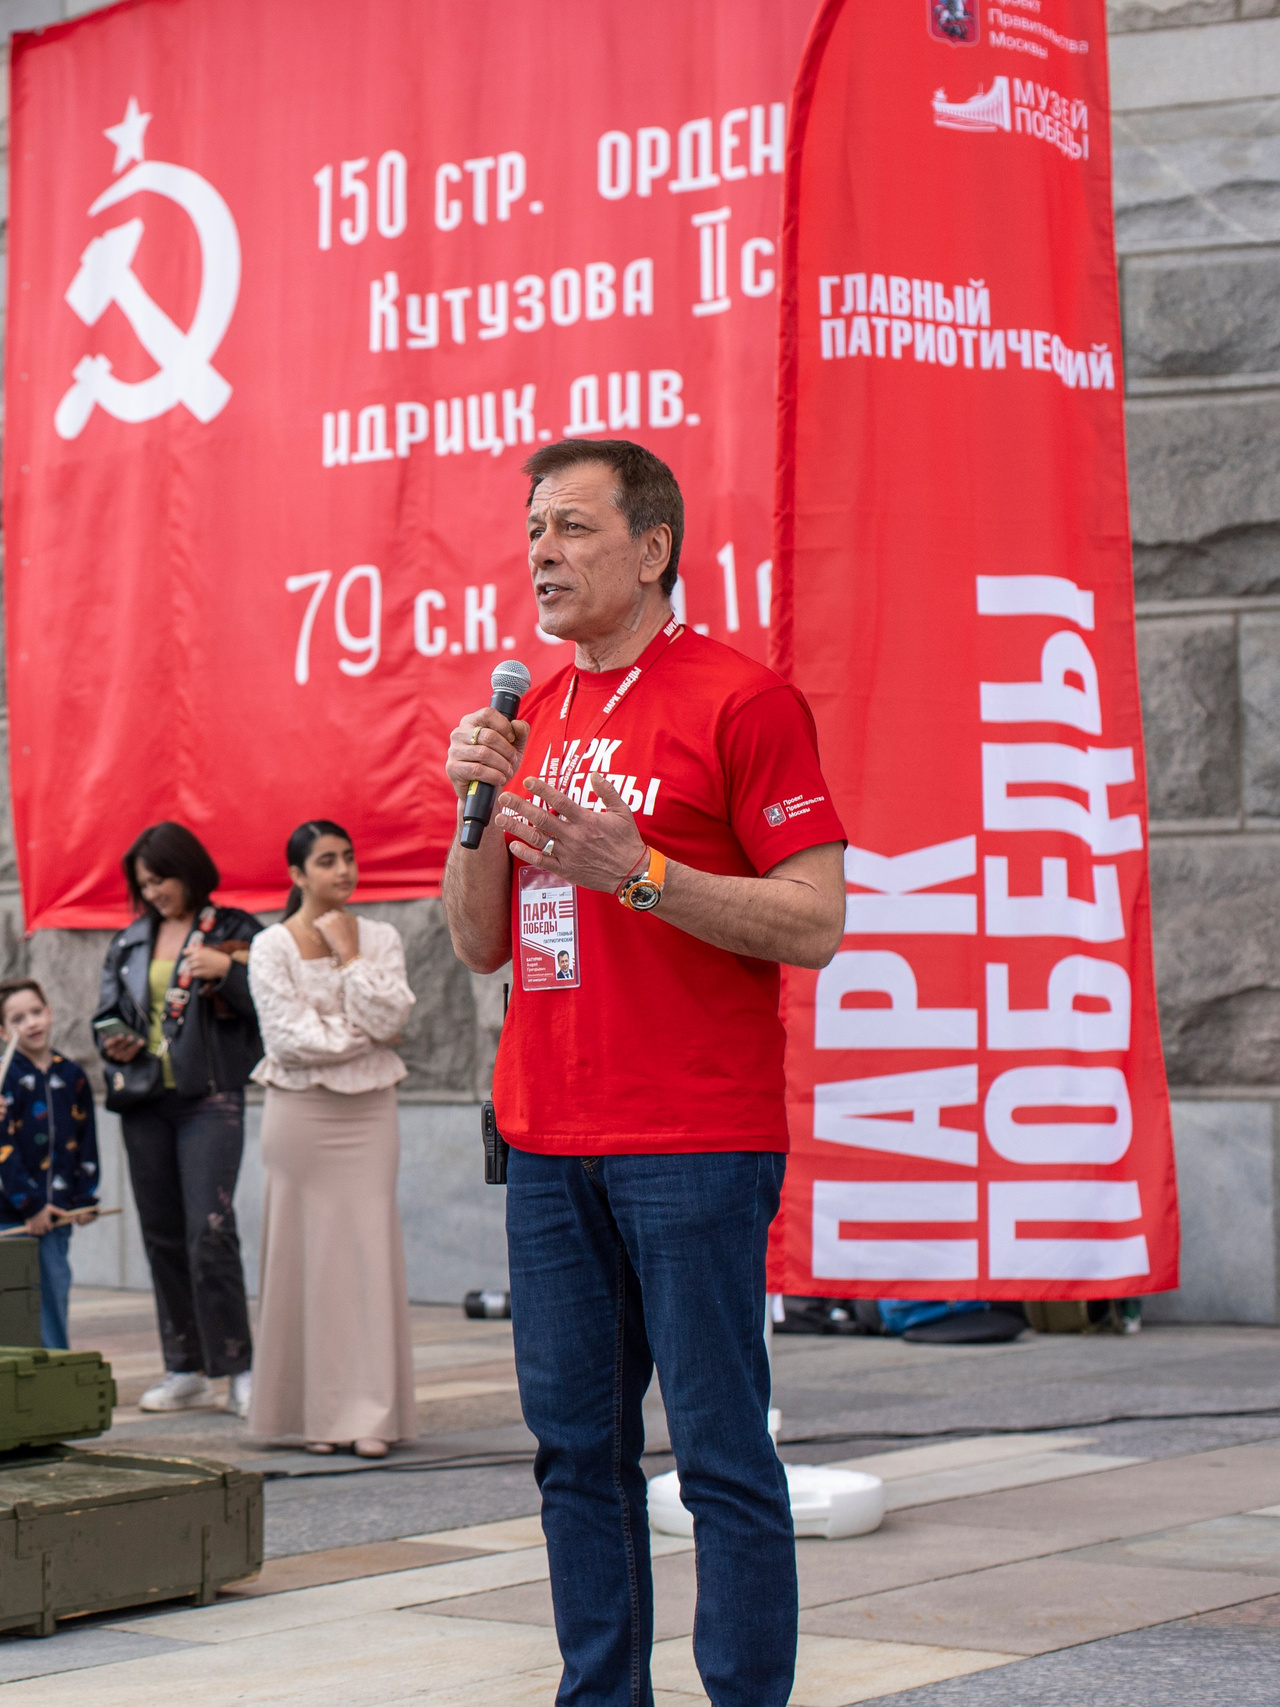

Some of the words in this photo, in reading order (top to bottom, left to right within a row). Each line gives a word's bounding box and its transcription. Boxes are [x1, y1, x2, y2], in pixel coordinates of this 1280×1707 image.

[989, 30, 1048, 60] Москвы
[1013, 77, 1089, 131] МУЗЕЙ
[1015, 106, 1089, 161] ПОБЕДЫ
[313, 149, 408, 251] 150
[434, 150, 544, 231] СТР.
[818, 273, 991, 327] ГЛАВНЫЙ
[820, 315, 1116, 391] ПАТРИОТИЧЕСИЙ
[563, 368, 701, 437] ДИВ.
[285, 564, 383, 686] 79
[602, 694, 621, 714] ПАРК
[616, 666, 642, 697] ПОБЕДЫ
[540, 738, 623, 776] РК
[531, 773, 661, 816] БЕДЫ
[782, 794, 803, 806] Проект
[788, 807, 811, 818] Москвы
[523, 901, 557, 921] ПАРК
[523, 921, 558, 935] ПОБЕДЫ
[976, 574, 1150, 1281] ПОБЕДЫ
[812, 836, 978, 1281] ПАРК
